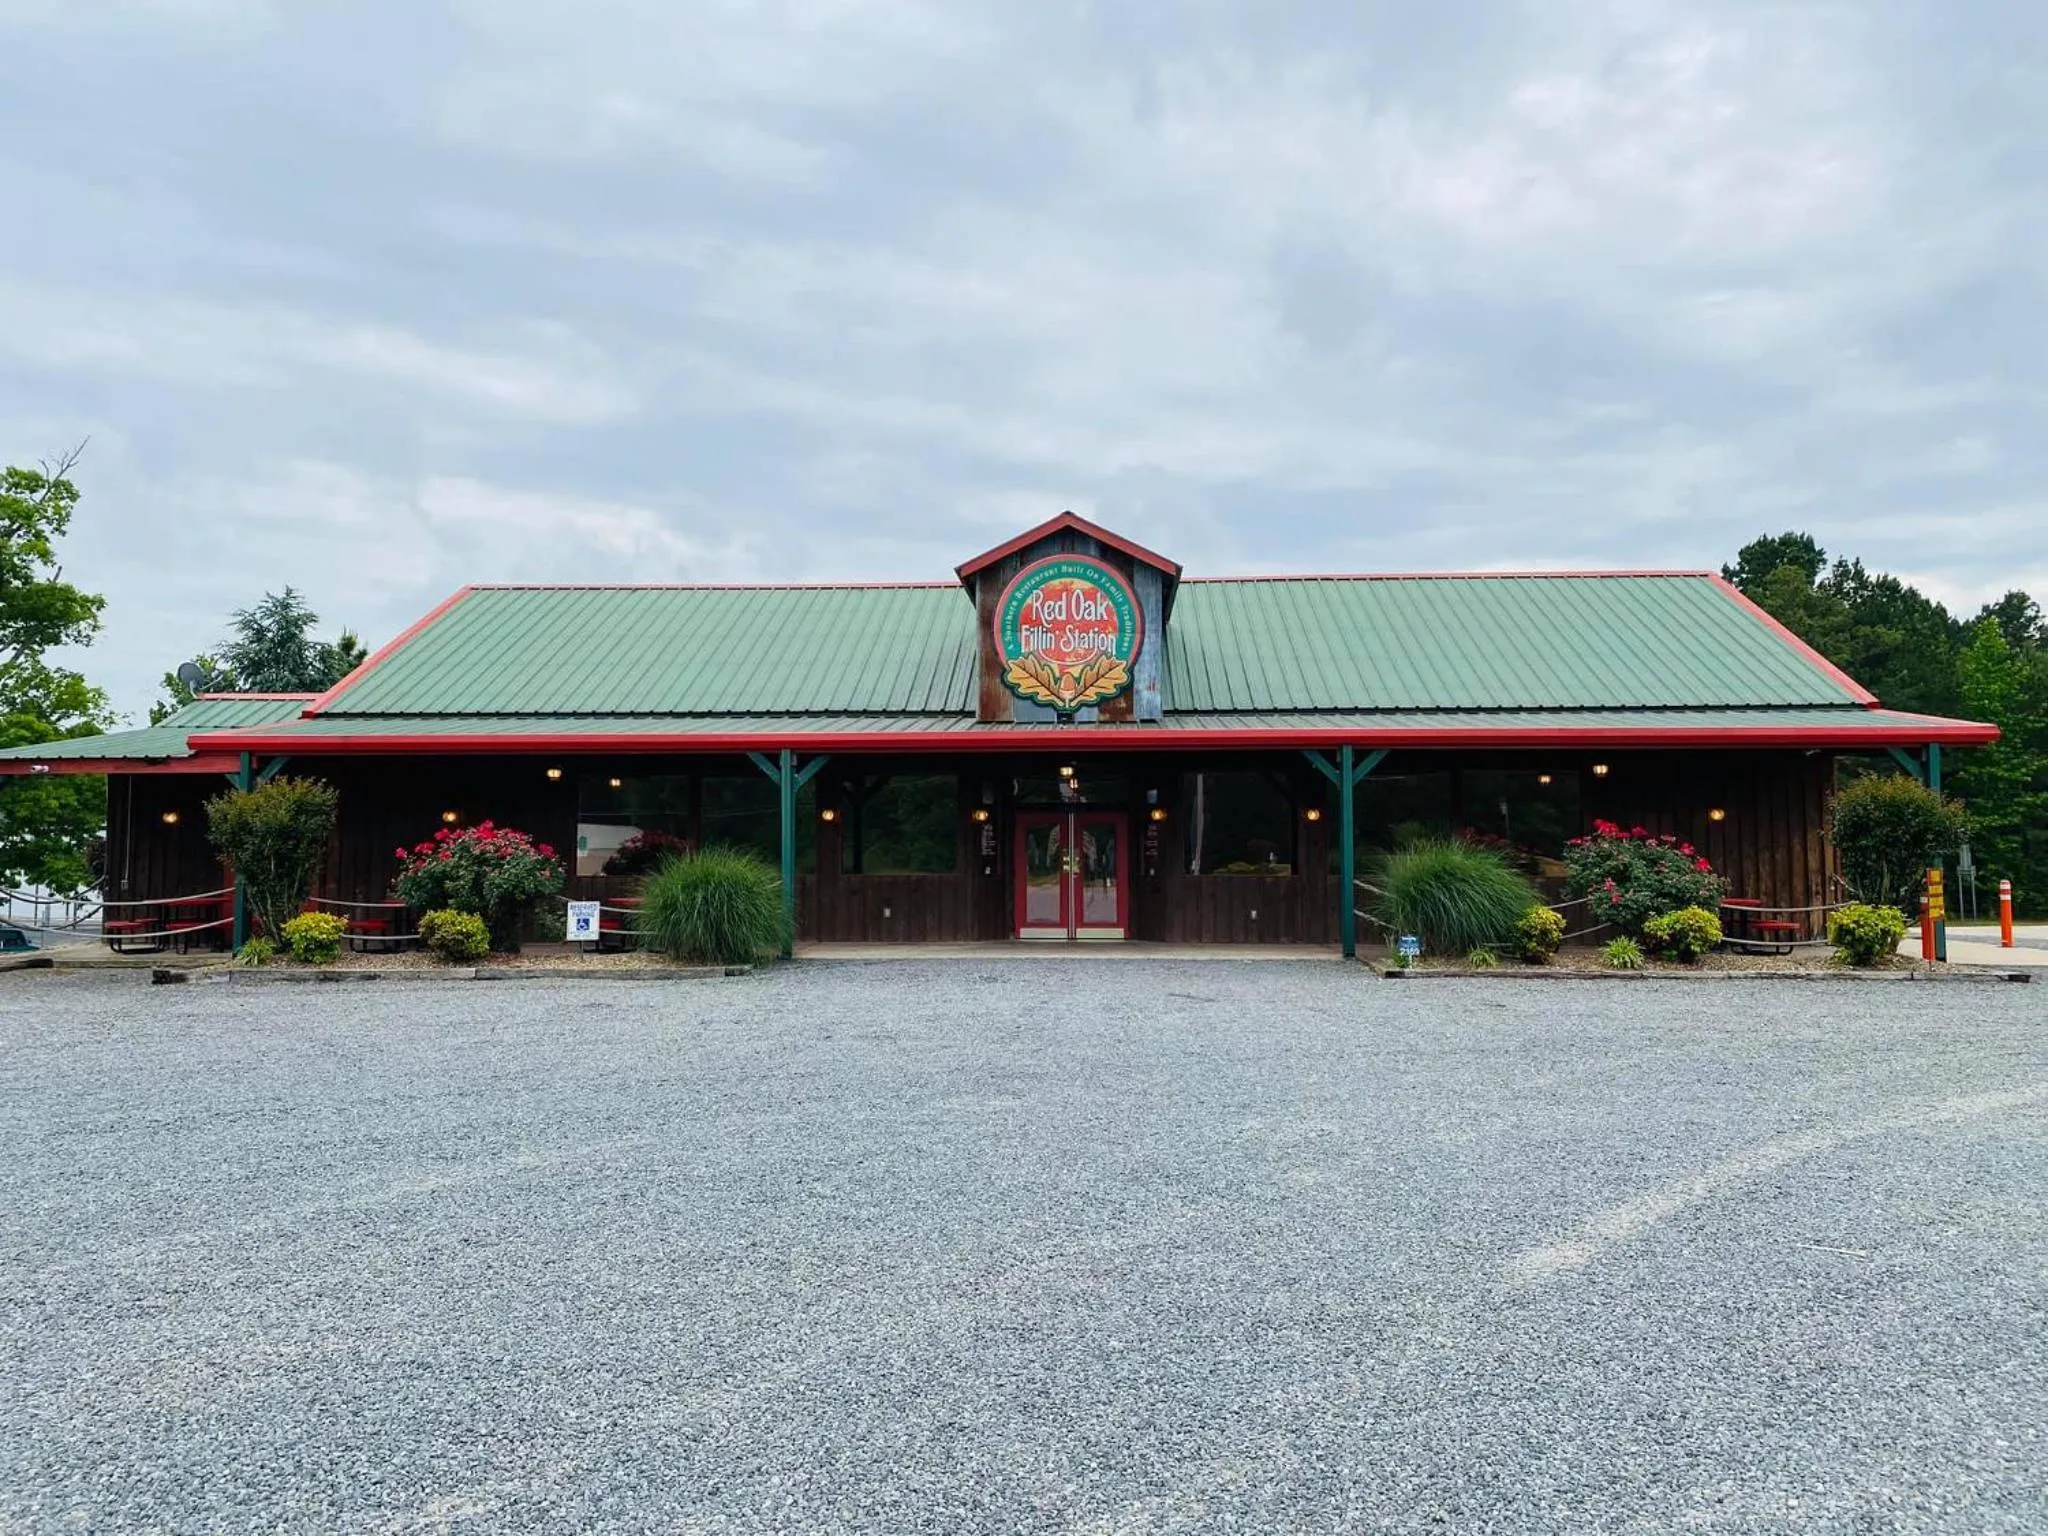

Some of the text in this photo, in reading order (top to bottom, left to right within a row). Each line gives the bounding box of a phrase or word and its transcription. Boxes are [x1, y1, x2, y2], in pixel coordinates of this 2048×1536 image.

[1032, 589, 1109, 627] Red Oak
[1020, 624, 1117, 656] Fillin' Station
